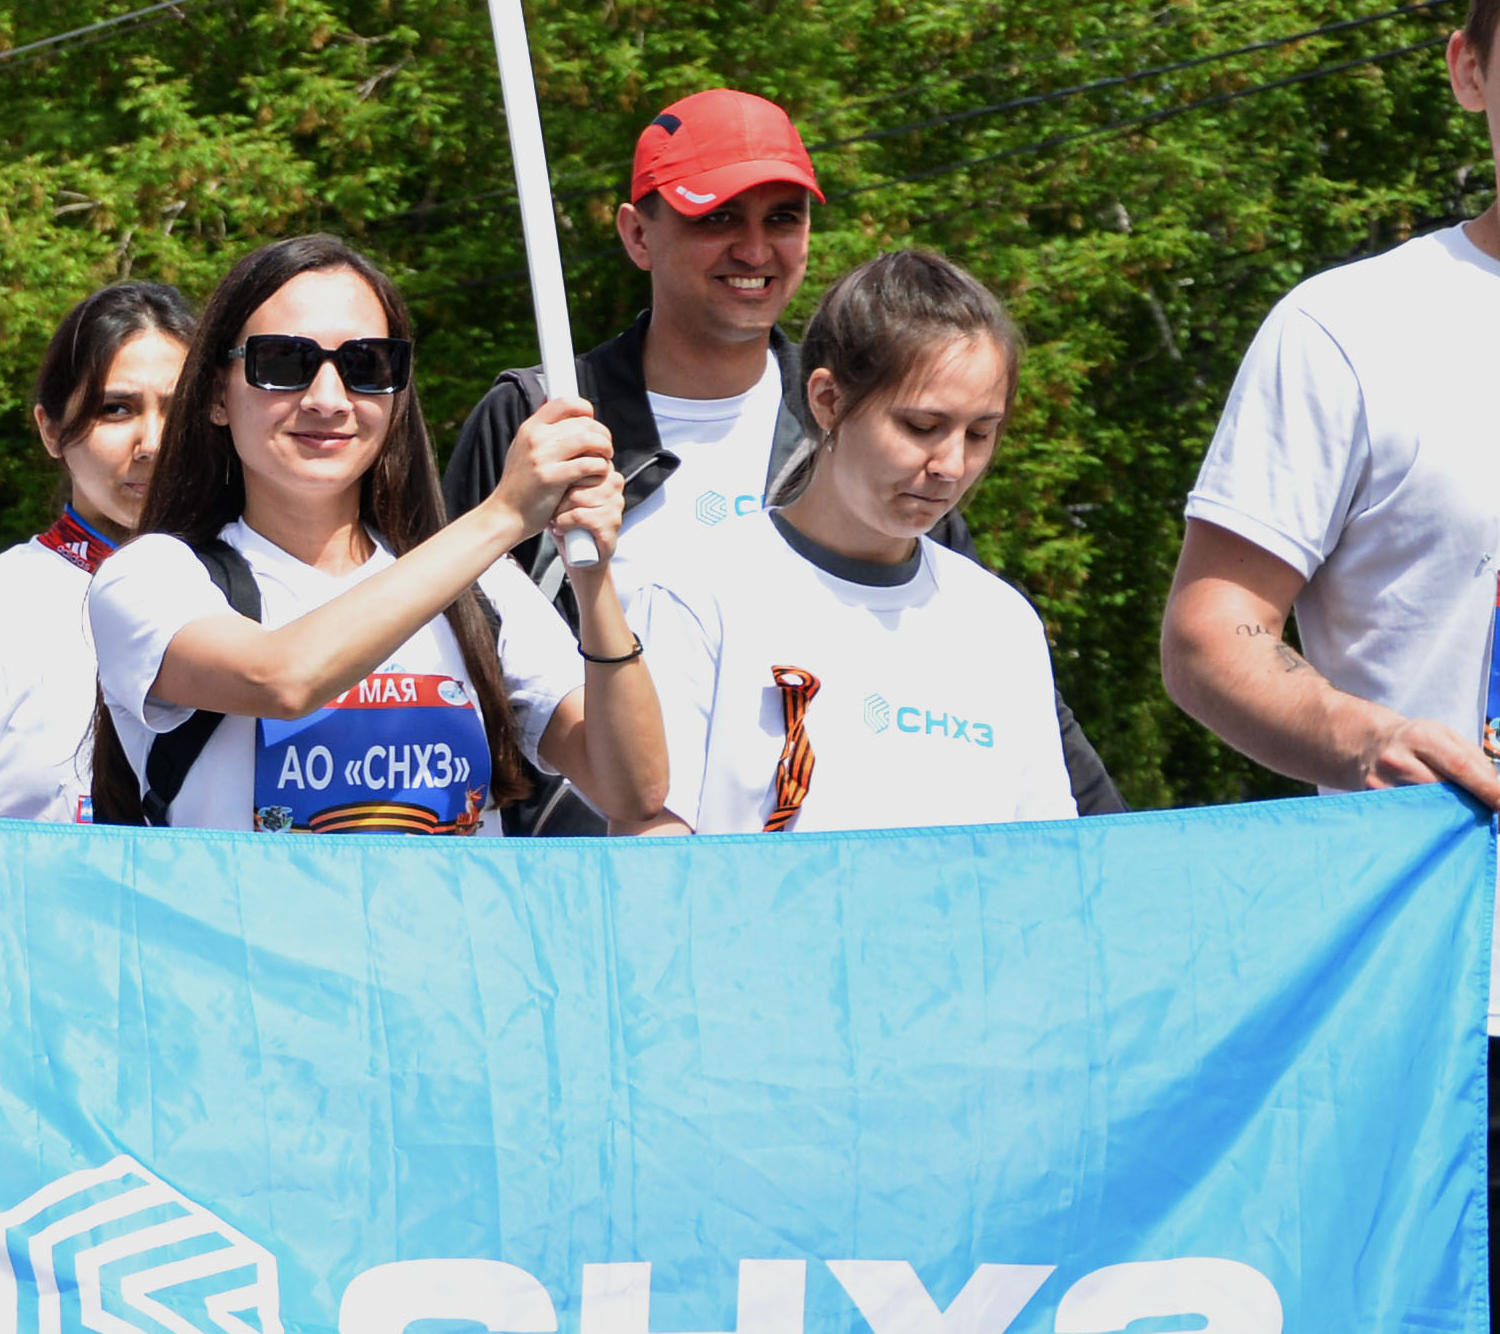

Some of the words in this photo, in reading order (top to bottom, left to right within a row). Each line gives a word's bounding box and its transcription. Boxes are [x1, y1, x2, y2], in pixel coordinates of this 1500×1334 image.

[358, 677, 418, 704] МАЯ
[896, 706, 995, 749] СНХЗ
[276, 744, 335, 791] АО
[344, 741, 472, 791] «СНХЗ»
